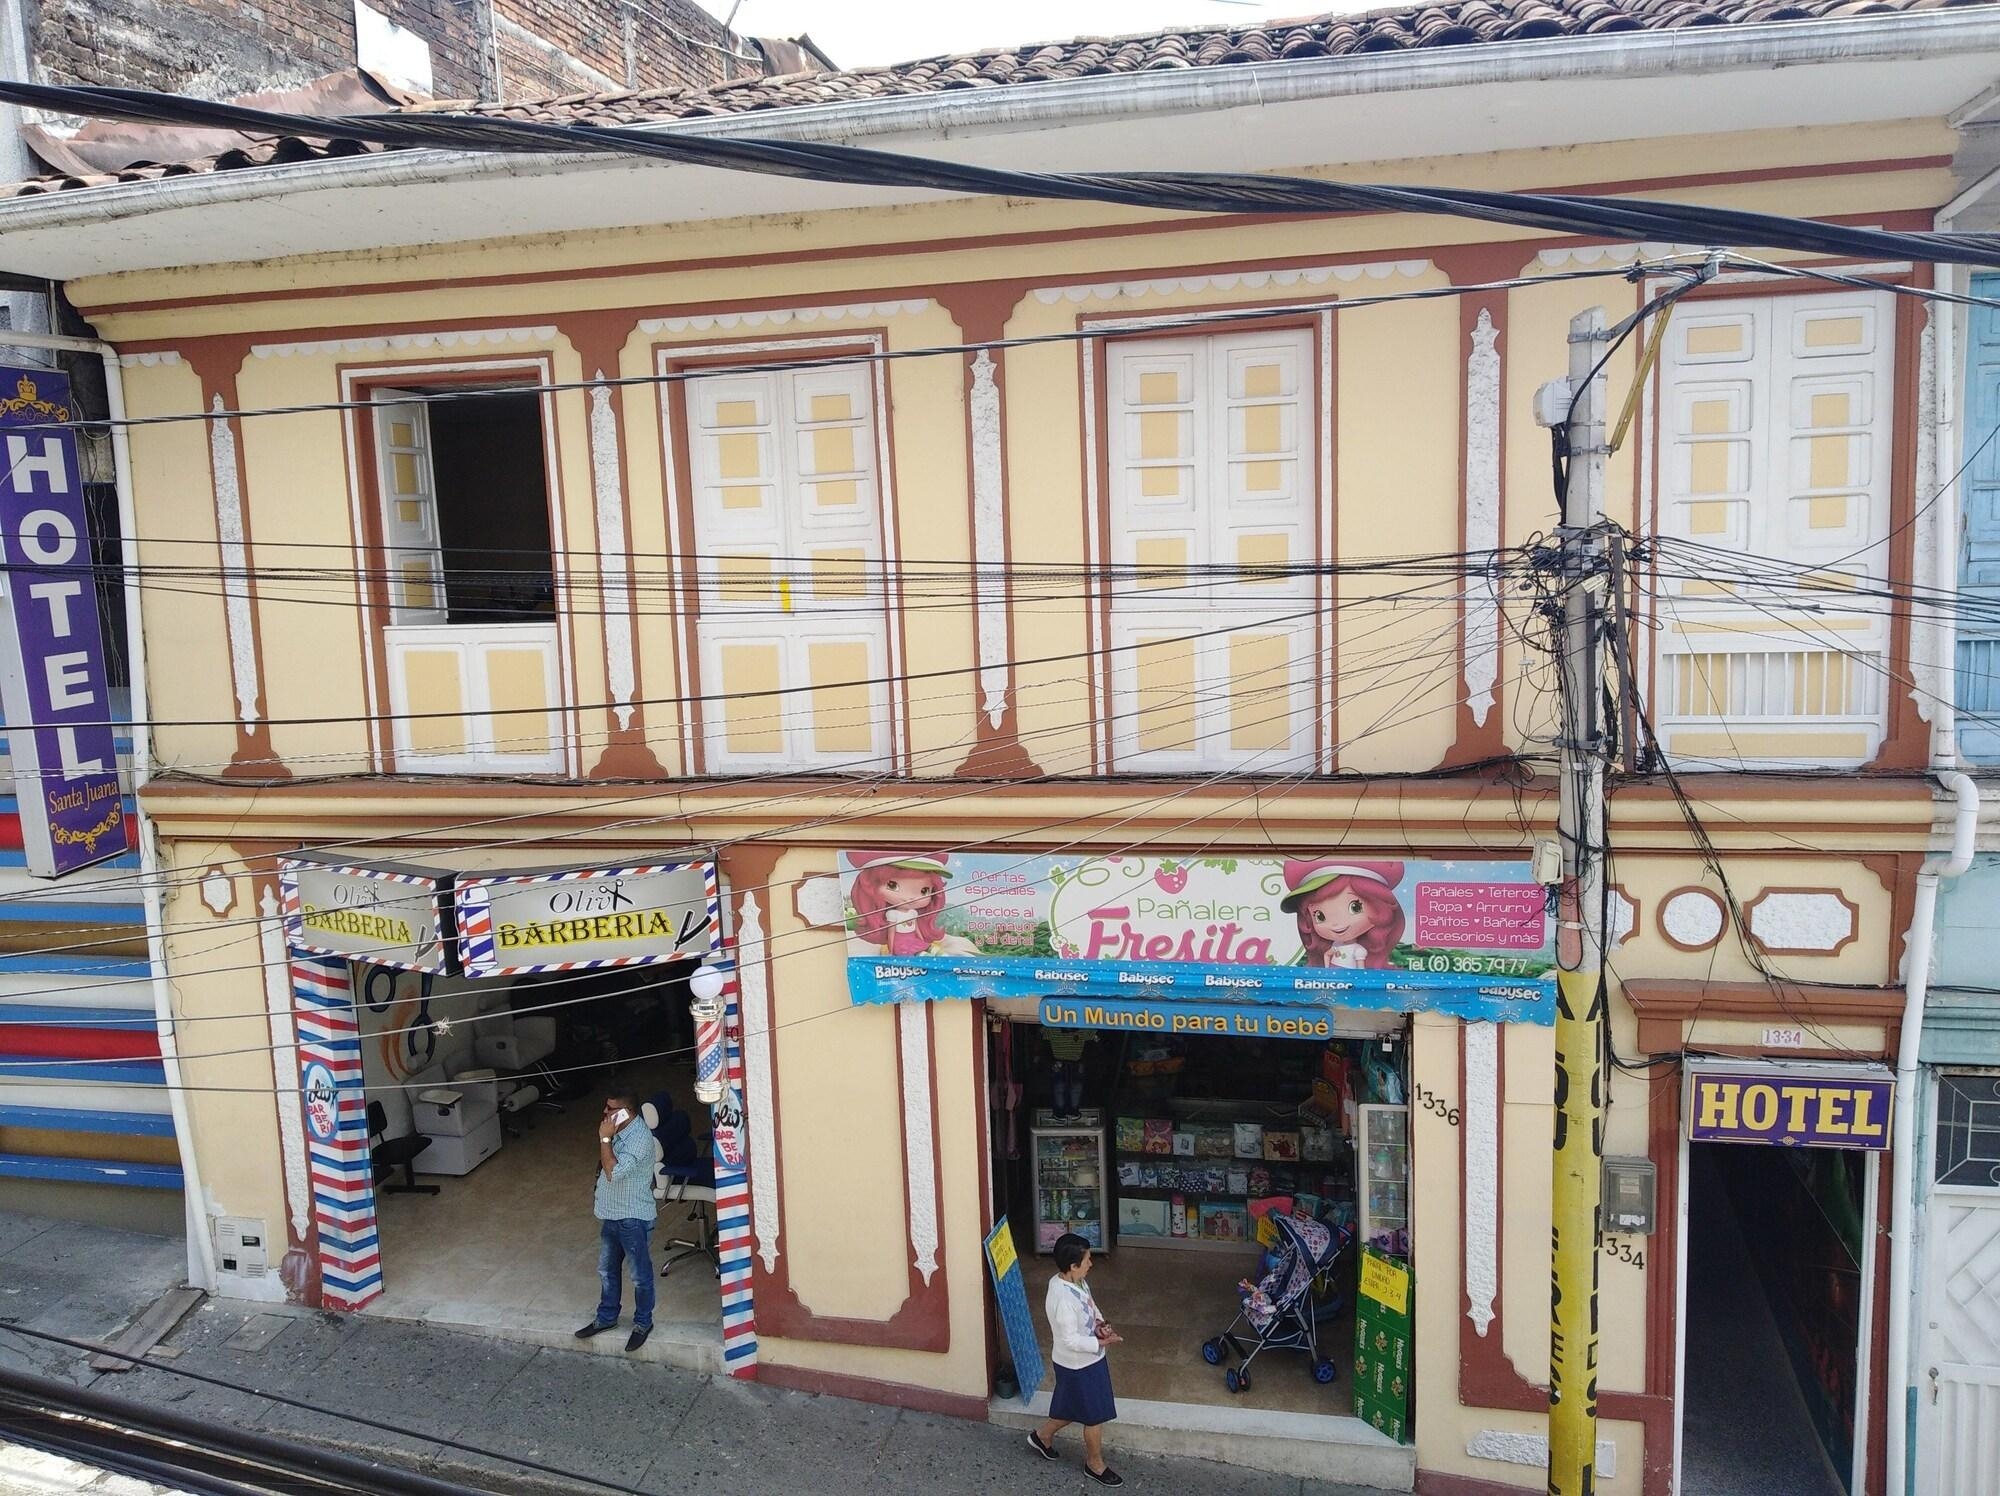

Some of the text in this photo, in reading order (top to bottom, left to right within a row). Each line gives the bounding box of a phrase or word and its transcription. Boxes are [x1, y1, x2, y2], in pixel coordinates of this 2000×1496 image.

[6, 436, 102, 782] HOTEL
[49, 781, 119, 814] Santa Juana
[965, 885, 1036, 897] especiales
[1421, 885, 1540, 899] Pañales Teteros
[970, 905, 1035, 918] Precios al
[1137, 897, 1271, 922] Pañalera
[1429, 900, 1532, 914] Ropa Arrurru
[304, 905, 412, 943] BARBERIA
[500, 911, 671, 947] BARBERIA
[968, 921, 1037, 933] por mayor
[1419, 915, 1541, 928] Pañitos Bañeras
[1083, 906, 1274, 965] Fresita
[1420, 929, 1540, 945] Accesorios y más
[874, 965, 928, 980] Babysec
[1453, 957, 1483, 973] 365
[1034, 968, 1089, 982] Babysec
[1118, 971, 1175, 985] Babysec
[1205, 974, 1263, 989] Babysec
[1294, 978, 1353, 990] Babysec
[1045, 1005, 1330, 1036] Un Mundo para tu bebé
[1415, 1083, 1460, 1127] 1336
[1698, 1082, 1882, 1136] HOTEL
